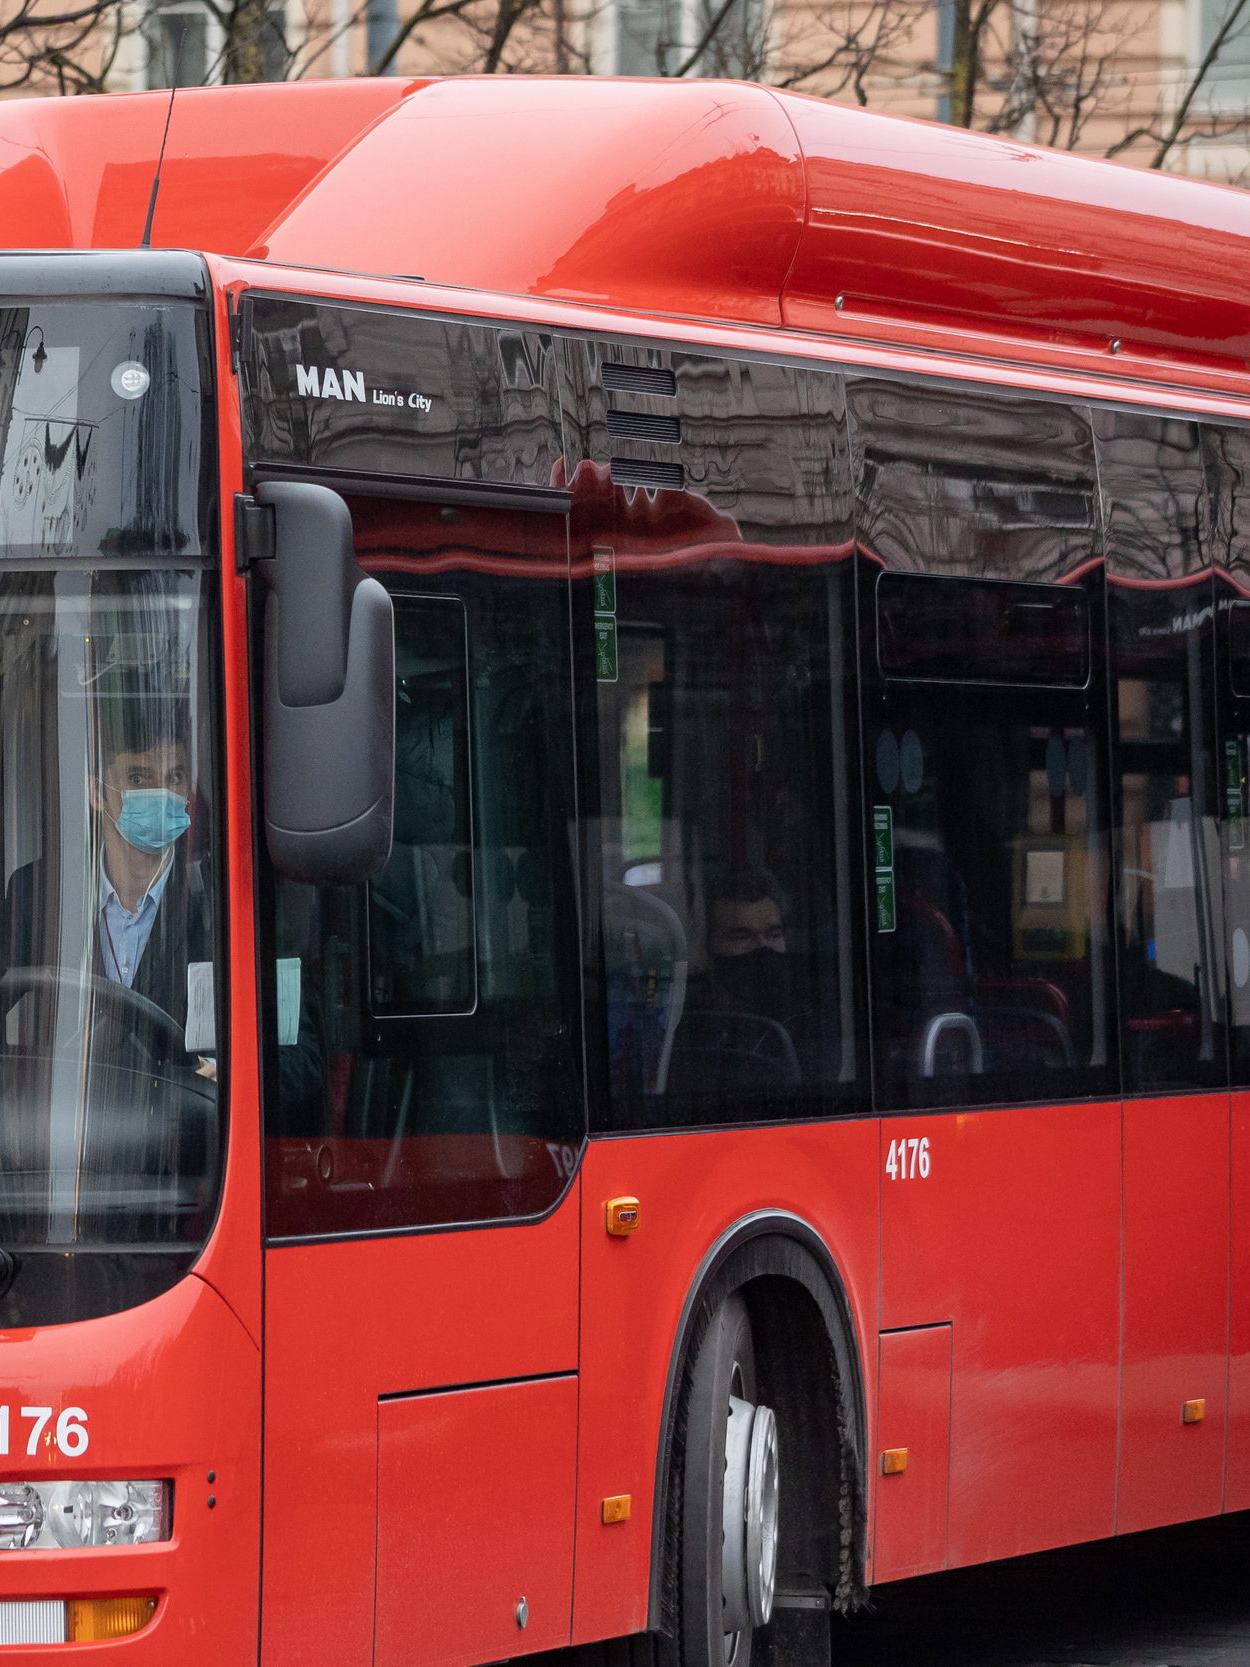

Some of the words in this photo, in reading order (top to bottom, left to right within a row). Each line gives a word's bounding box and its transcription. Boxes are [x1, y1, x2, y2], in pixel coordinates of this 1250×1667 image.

[296, 364, 367, 402] MAN
[373, 390, 404, 406] Lion's
[408, 392, 432, 413] City
[885, 1137, 931, 1181] 4176
